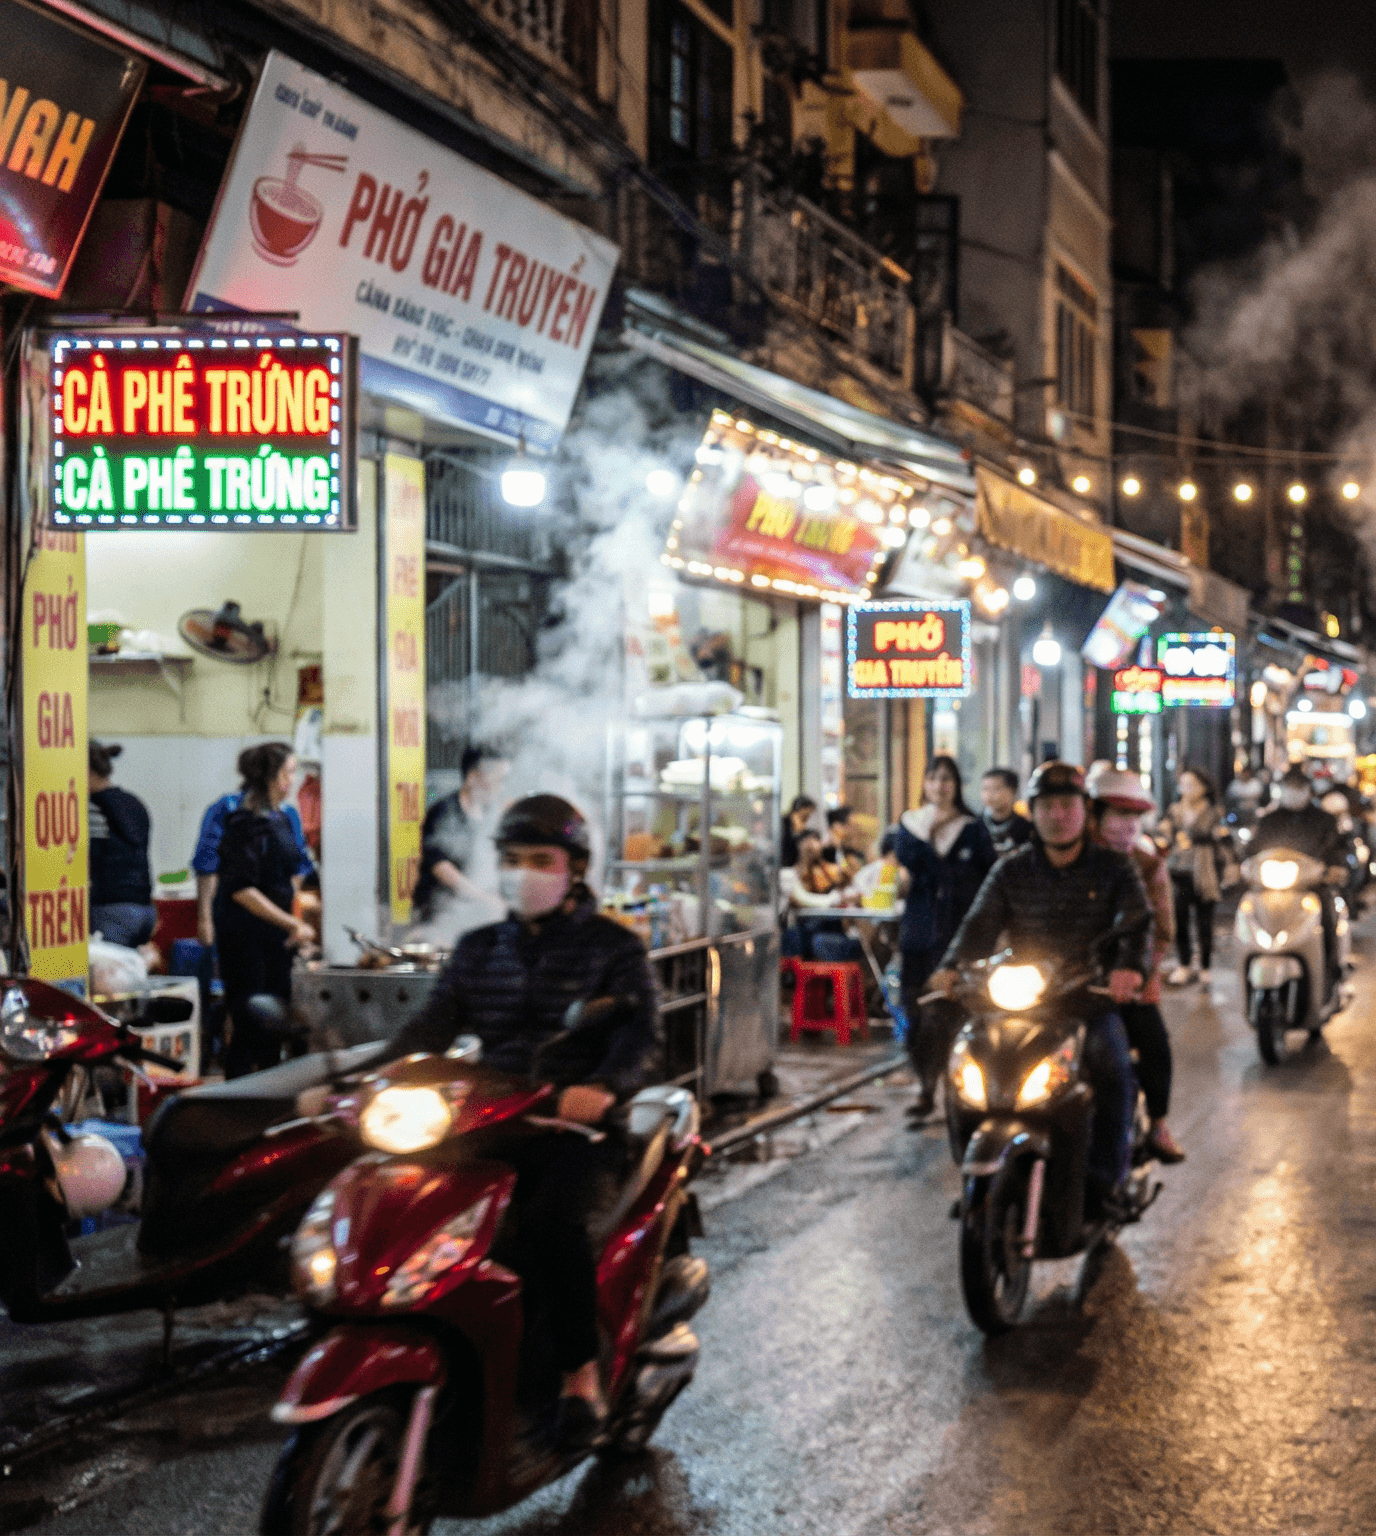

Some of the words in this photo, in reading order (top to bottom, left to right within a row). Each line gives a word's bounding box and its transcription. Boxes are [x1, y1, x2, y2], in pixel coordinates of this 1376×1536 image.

[339, 170, 429, 273] PHỞ
[421, 214, 483, 304] GIA
[63, 353, 115, 433] CÀ
[123, 353, 196, 433] PHÊ
[205, 352, 331, 434] TRỨNG
[63, 444, 115, 510] CÀ
[123, 444, 196, 510] PHÊ
[204, 443, 331, 511] TRỨNG
[37, 691, 76, 749] GIA
